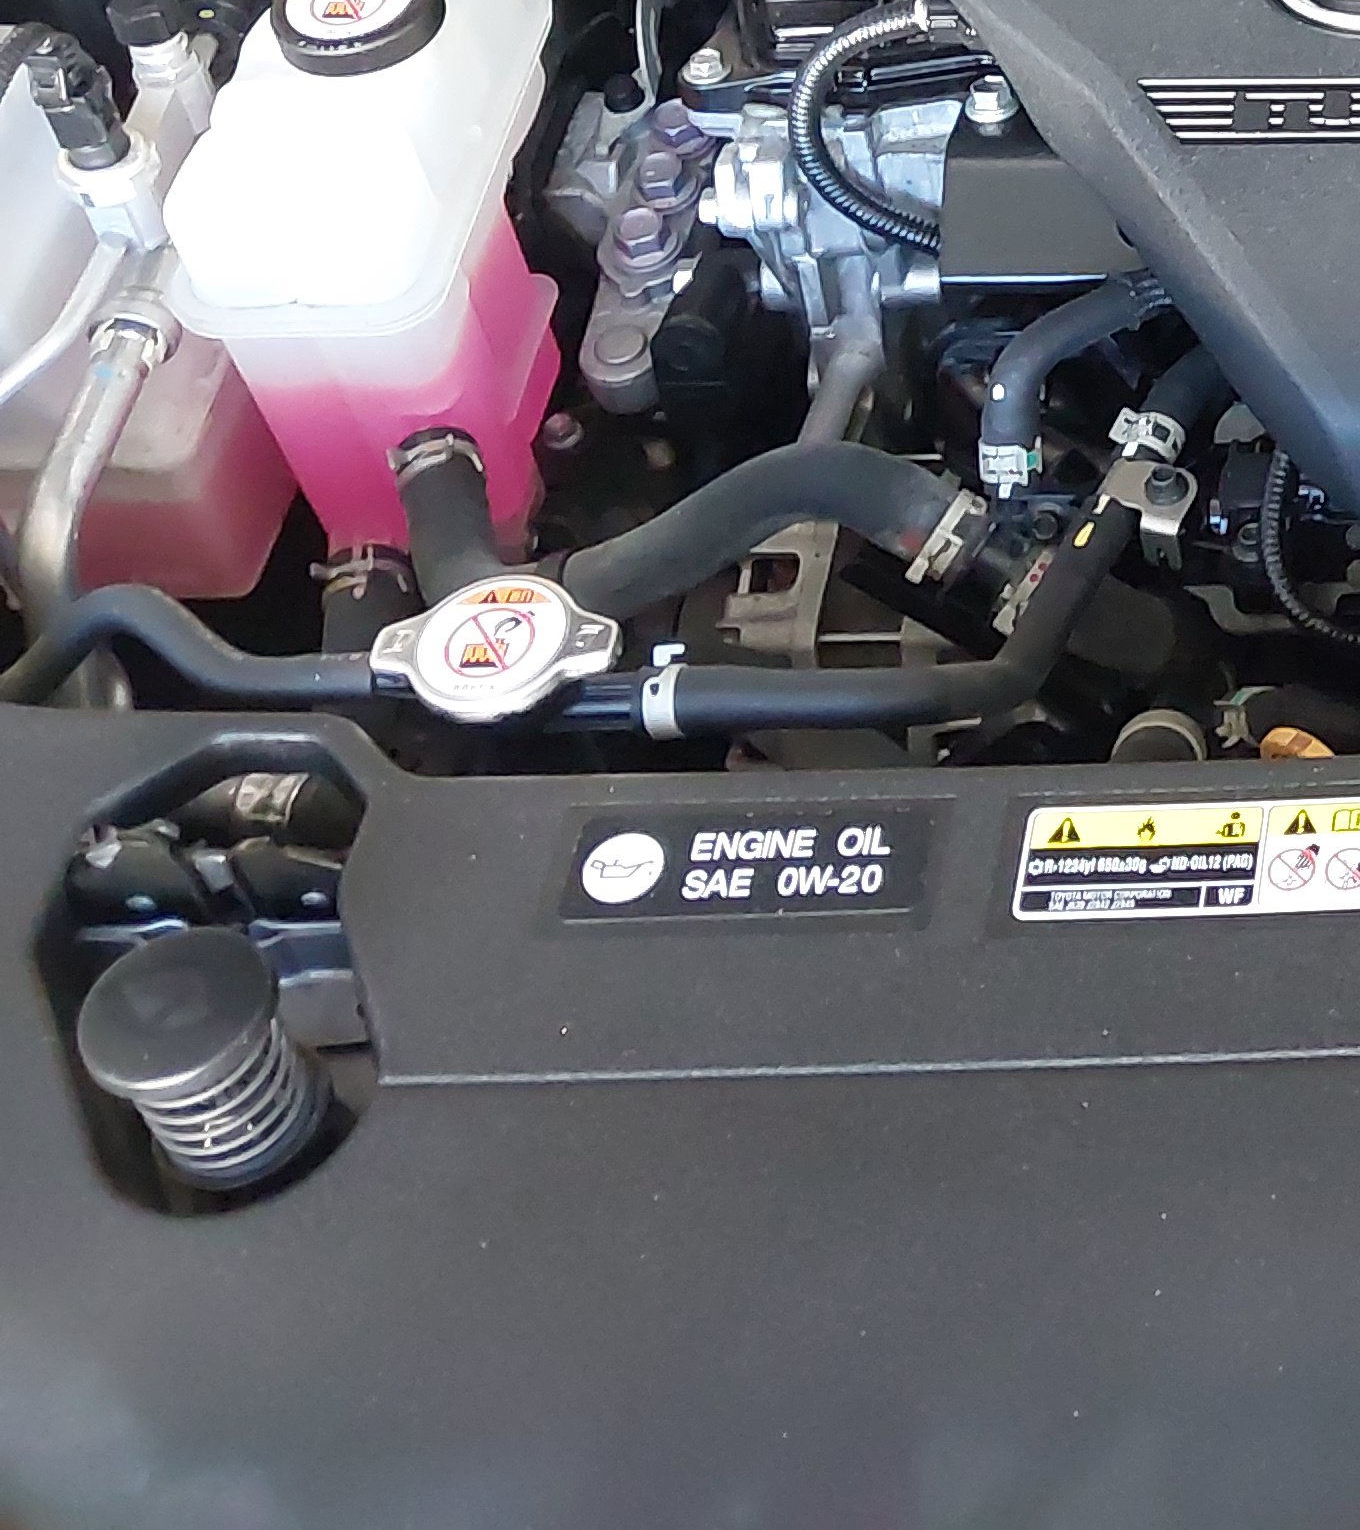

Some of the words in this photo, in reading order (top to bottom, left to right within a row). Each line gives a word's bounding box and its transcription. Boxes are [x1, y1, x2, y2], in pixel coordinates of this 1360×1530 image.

[690, 828, 817, 861] ENGINE
[836, 824, 891, 857] OIL
[681, 867, 755, 901] SAE
[776, 863, 883, 898] 0W-20
[1217, 887, 1245, 905] WF
